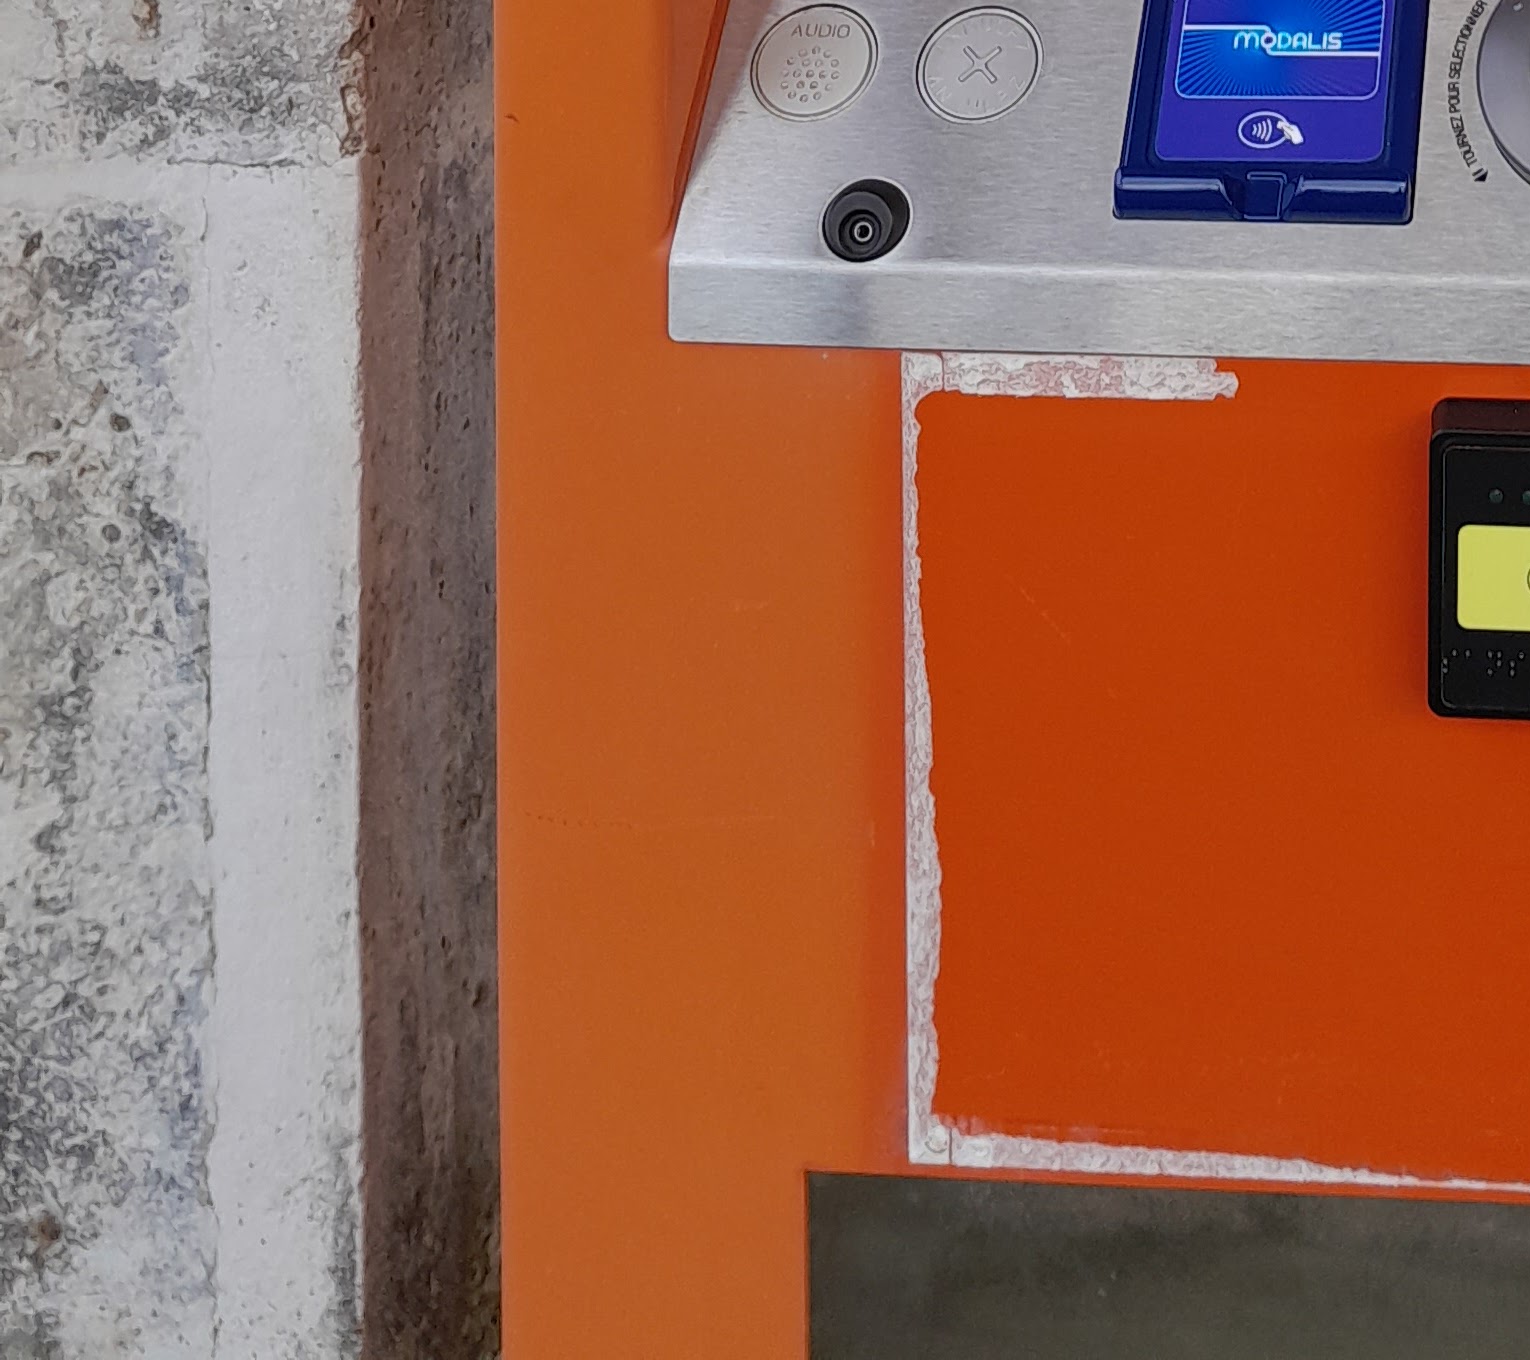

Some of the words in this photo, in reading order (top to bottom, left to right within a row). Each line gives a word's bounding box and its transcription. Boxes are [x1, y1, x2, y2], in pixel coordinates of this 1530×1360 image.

[791, 24, 851, 38] AUDIO
[1233, 31, 1343, 50] MODALIS
[1450, 0, 1487, 79] SELECTIONNER
[1449, 81, 1461, 113] POUR
[1450, 115, 1477, 168] TOURNEZ
